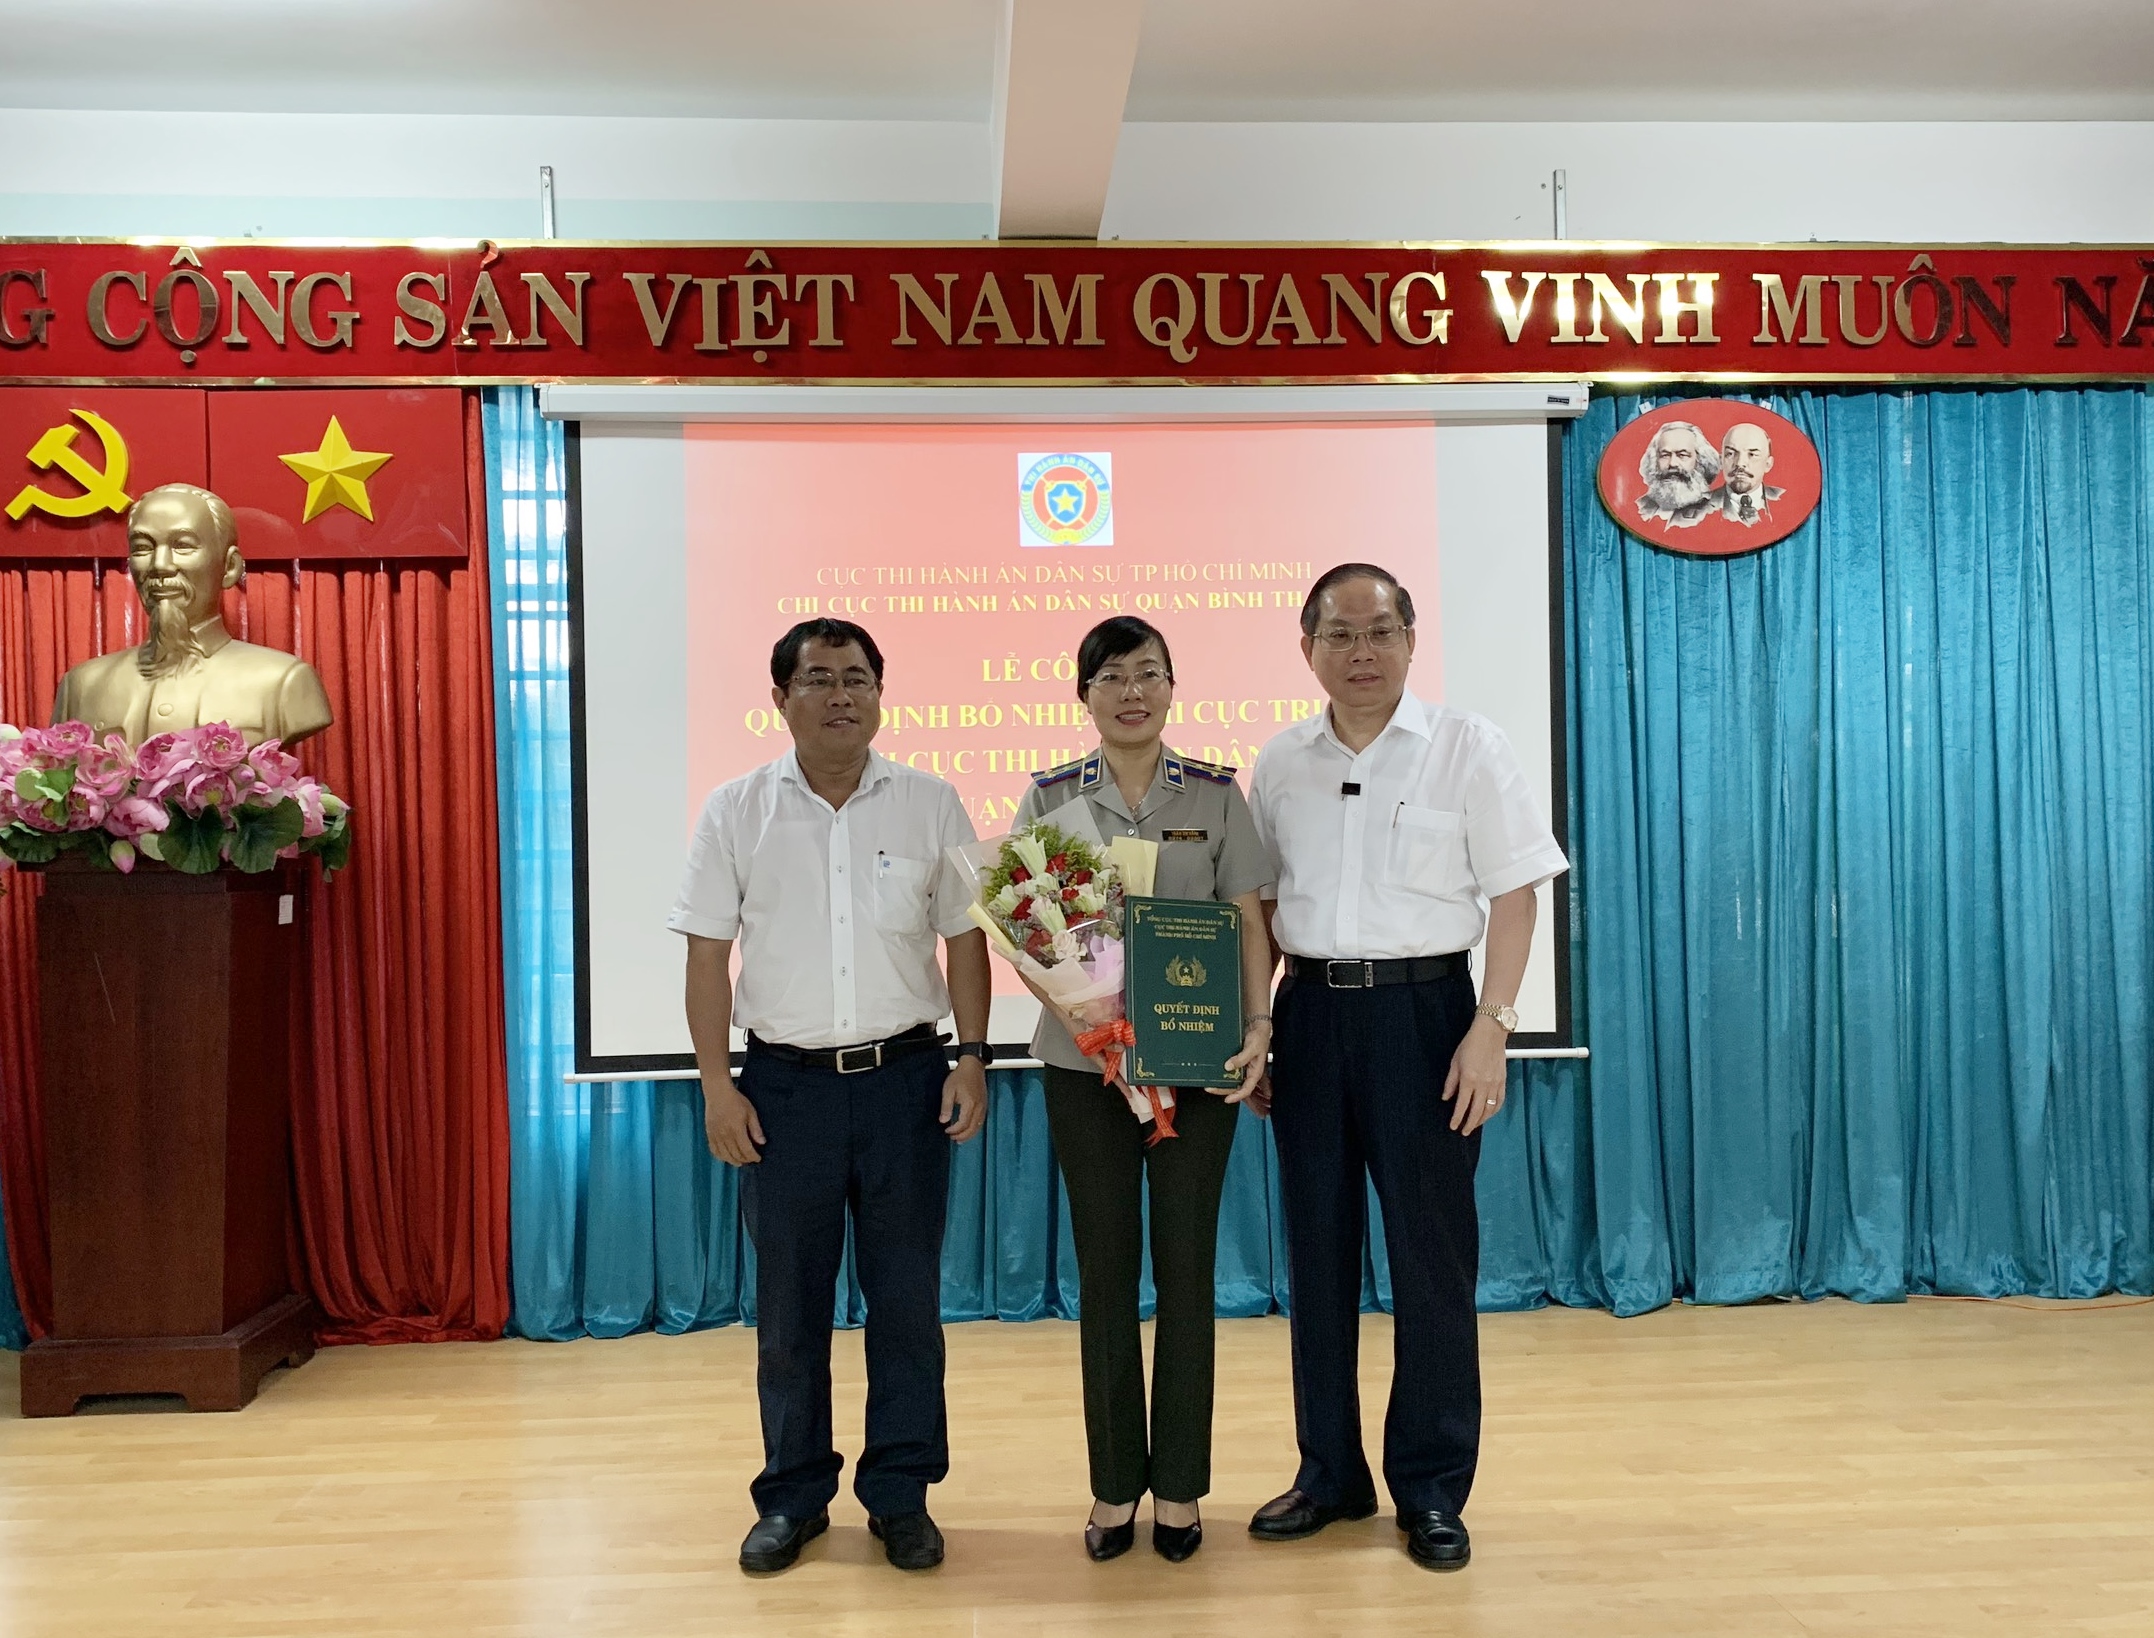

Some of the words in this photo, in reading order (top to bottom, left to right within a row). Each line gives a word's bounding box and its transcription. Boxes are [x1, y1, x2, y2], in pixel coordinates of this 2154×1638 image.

[87, 246, 360, 363] CỘNG
[394, 240, 591, 347] SẢN
[623, 250, 854, 363] VIỆT
[890, 271, 1105, 345] NAM
[1133, 271, 1453, 363] QUANG
[1481, 270, 1721, 345] VINH
[1752, 254, 2015, 346] MUÔN
[817, 567, 866, 590] CỤC
[873, 566, 913, 585] THI
[920, 562, 988, 585] HÀNH
[995, 561, 1027, 584] ÁN
[1035, 560, 1084, 583] DÂN
[1092, 562, 1124, 586] SỰ
[1129, 564, 1157, 582] TP
[1203, 559, 1242, 581] CHÍ
[1250, 561, 1312, 581] MINH
[777, 596, 819, 614] CHI
[828, 596, 877, 617] CỤC
[884, 595, 924, 613] THI
[932, 590, 998, 613] HÀNH
[1006, 589, 1037, 612] ÁN
[1046, 589, 1091, 611] DÂN
[1100, 590, 1130, 614] SỰ
[1135, 590, 1200, 614] QUẬN
[1208, 587, 1263, 609] BÌNH
[982, 651, 1022, 682] LỄ
[1193, 700, 1259, 730] CỤC
[907, 750, 974, 779] CỤC
[983, 748, 1041, 773] THI
[1154, 1001, 1190, 1014] QUYẾT
[1192, 1005, 1220, 1016] ĐỊNH
[1179, 1019, 1214, 1033] NHIỆM
